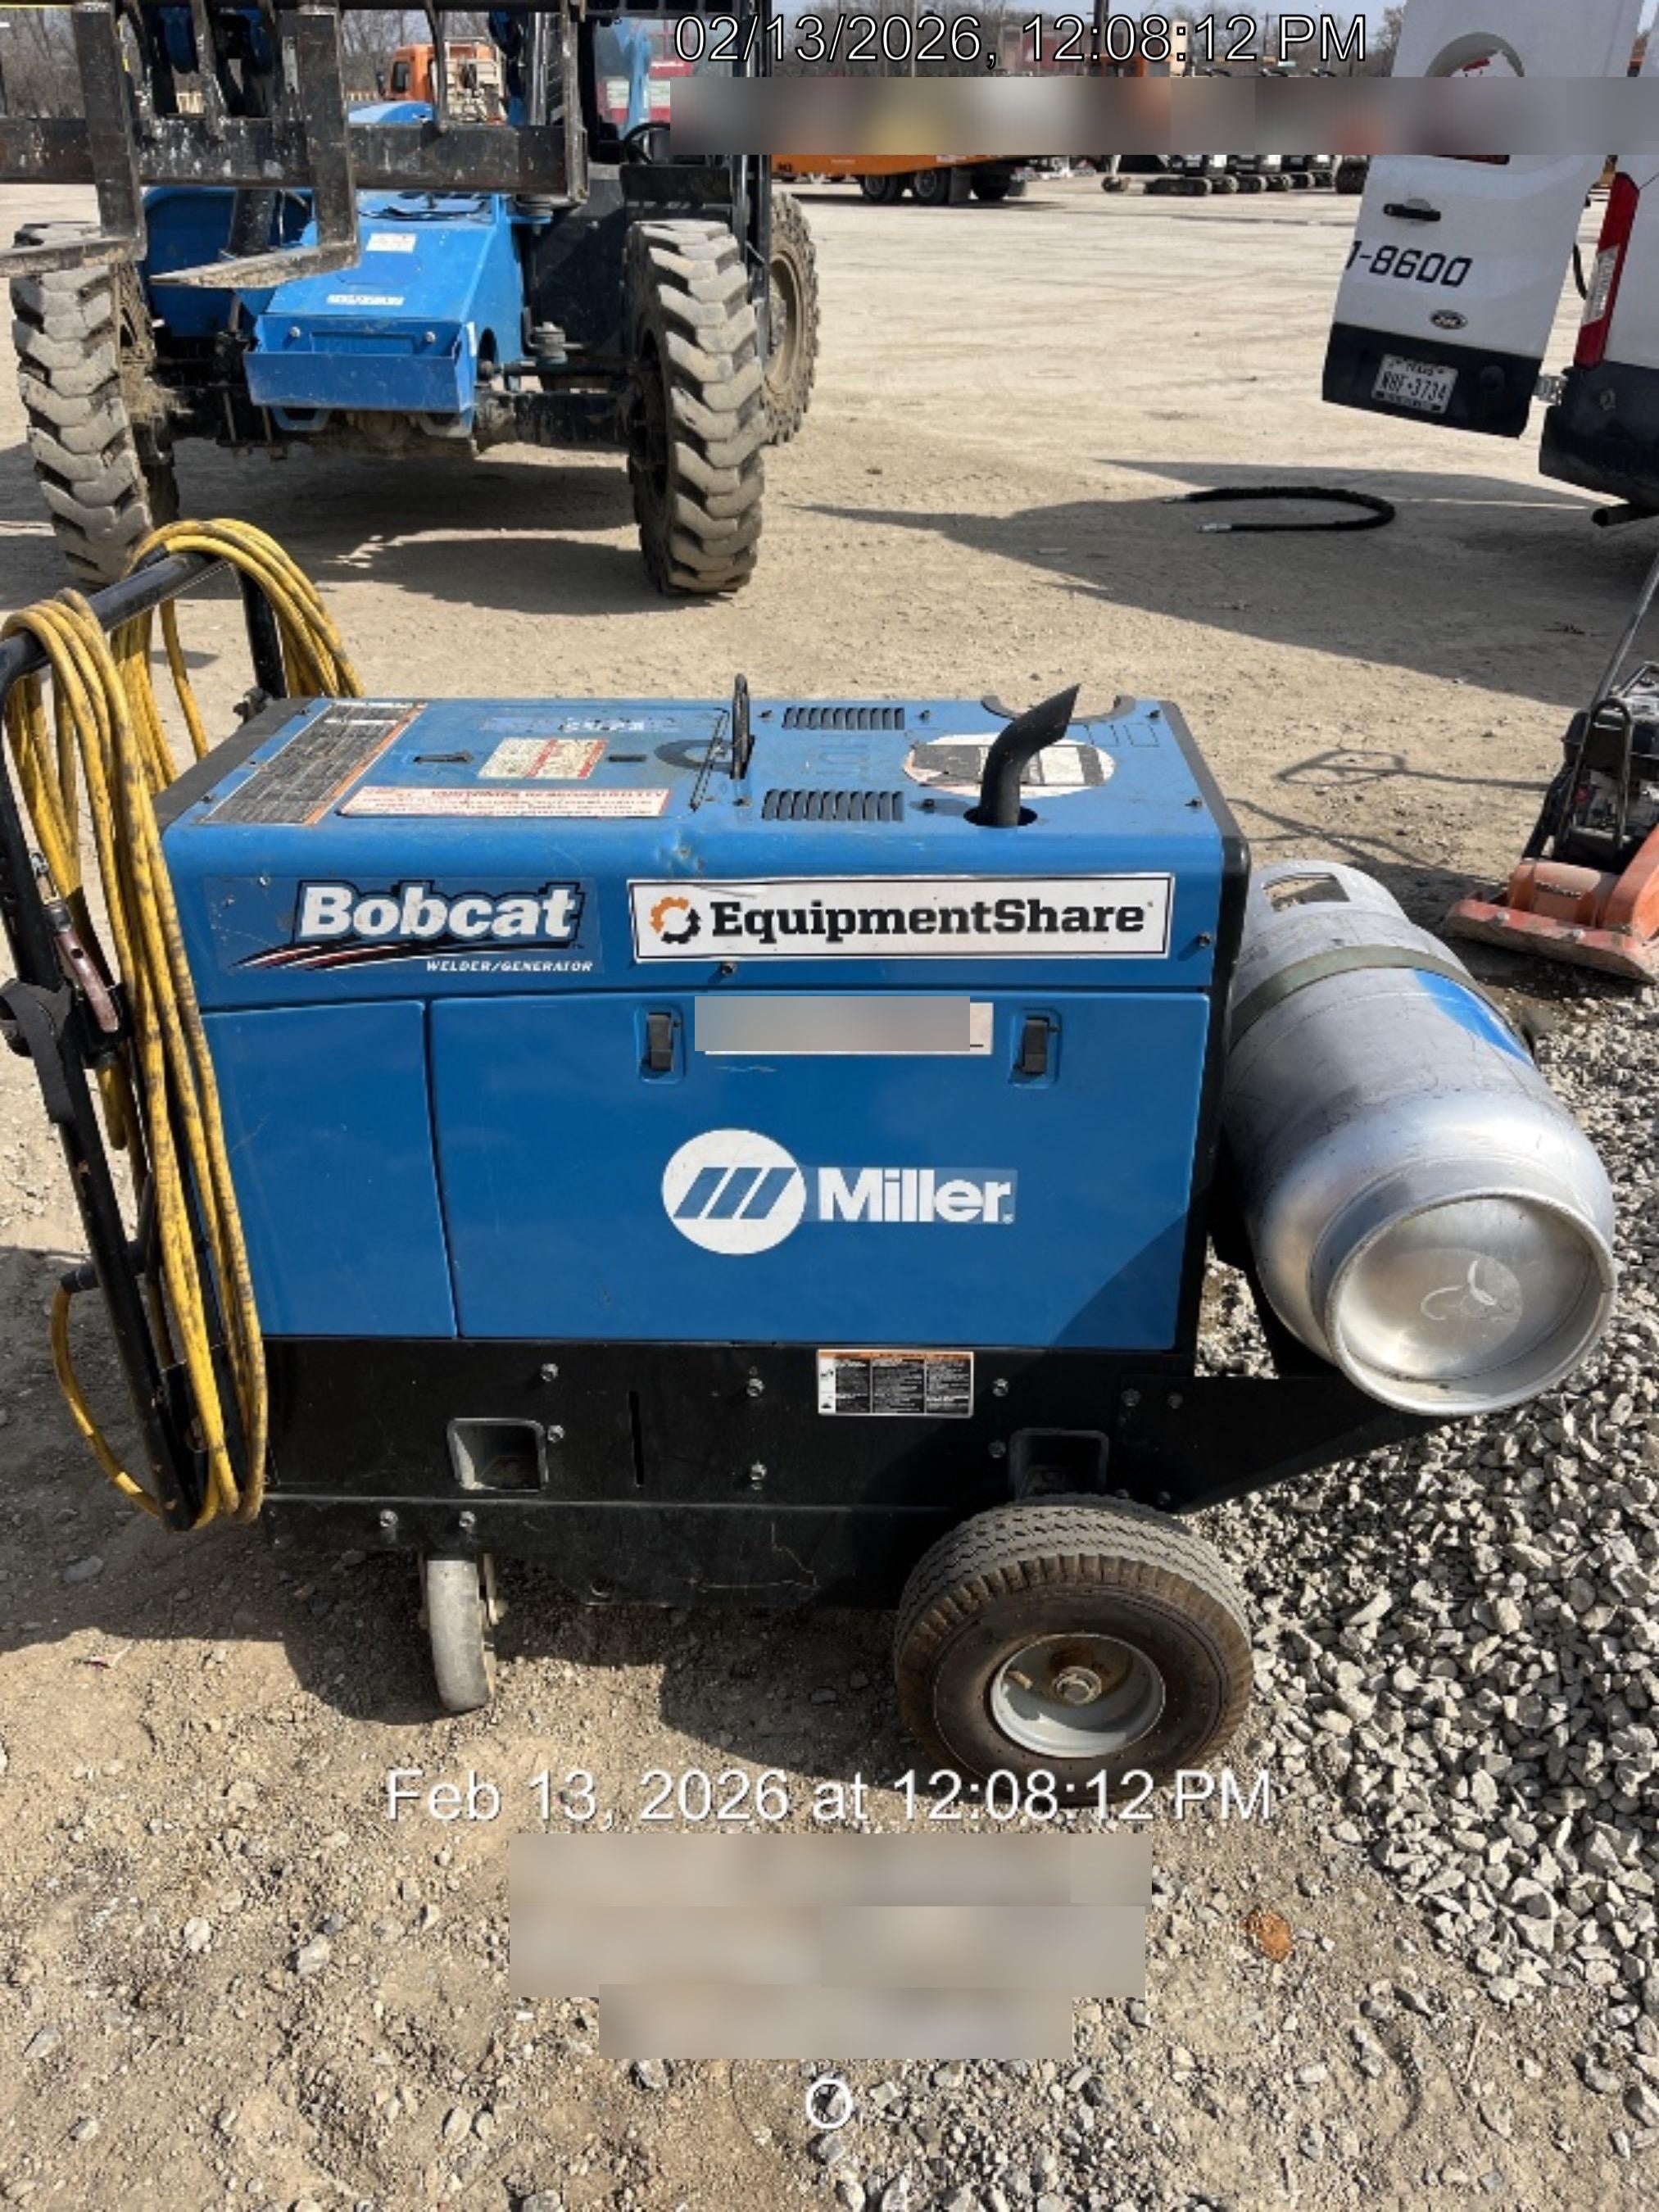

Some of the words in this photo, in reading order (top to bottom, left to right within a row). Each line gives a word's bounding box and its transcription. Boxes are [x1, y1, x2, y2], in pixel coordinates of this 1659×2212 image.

[300, 886, 576, 937] Bobcat
[709, 899, 1145, 944] EquipmentShare
[425, 959, 593, 972] WELDER/GENERATOR
[818, 1167, 1011, 1222] Miller
